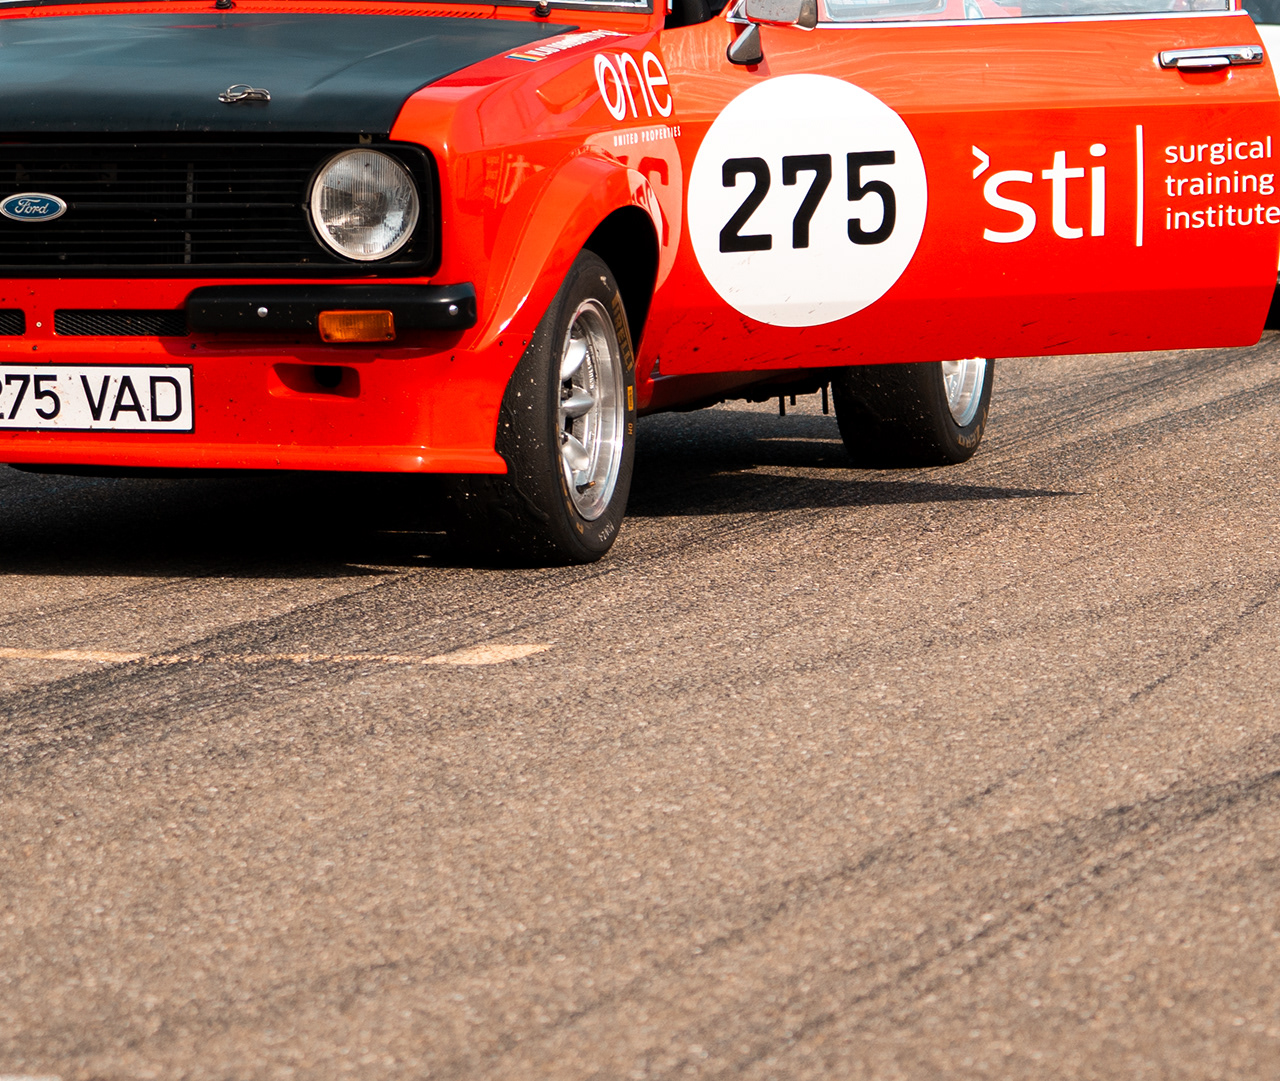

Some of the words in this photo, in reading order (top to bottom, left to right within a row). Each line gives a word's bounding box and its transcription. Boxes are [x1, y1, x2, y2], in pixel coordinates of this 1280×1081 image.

[593, 50, 673, 121] one
[613, 131, 639, 147] UNITED
[641, 125, 682, 143] PROPERTIES
[1164, 136, 1273, 165] surgical
[1164, 171, 1275, 197] training
[14, 198, 50, 214] Ford
[719, 150, 896, 253] 275
[80, 374, 183, 423] VAD
